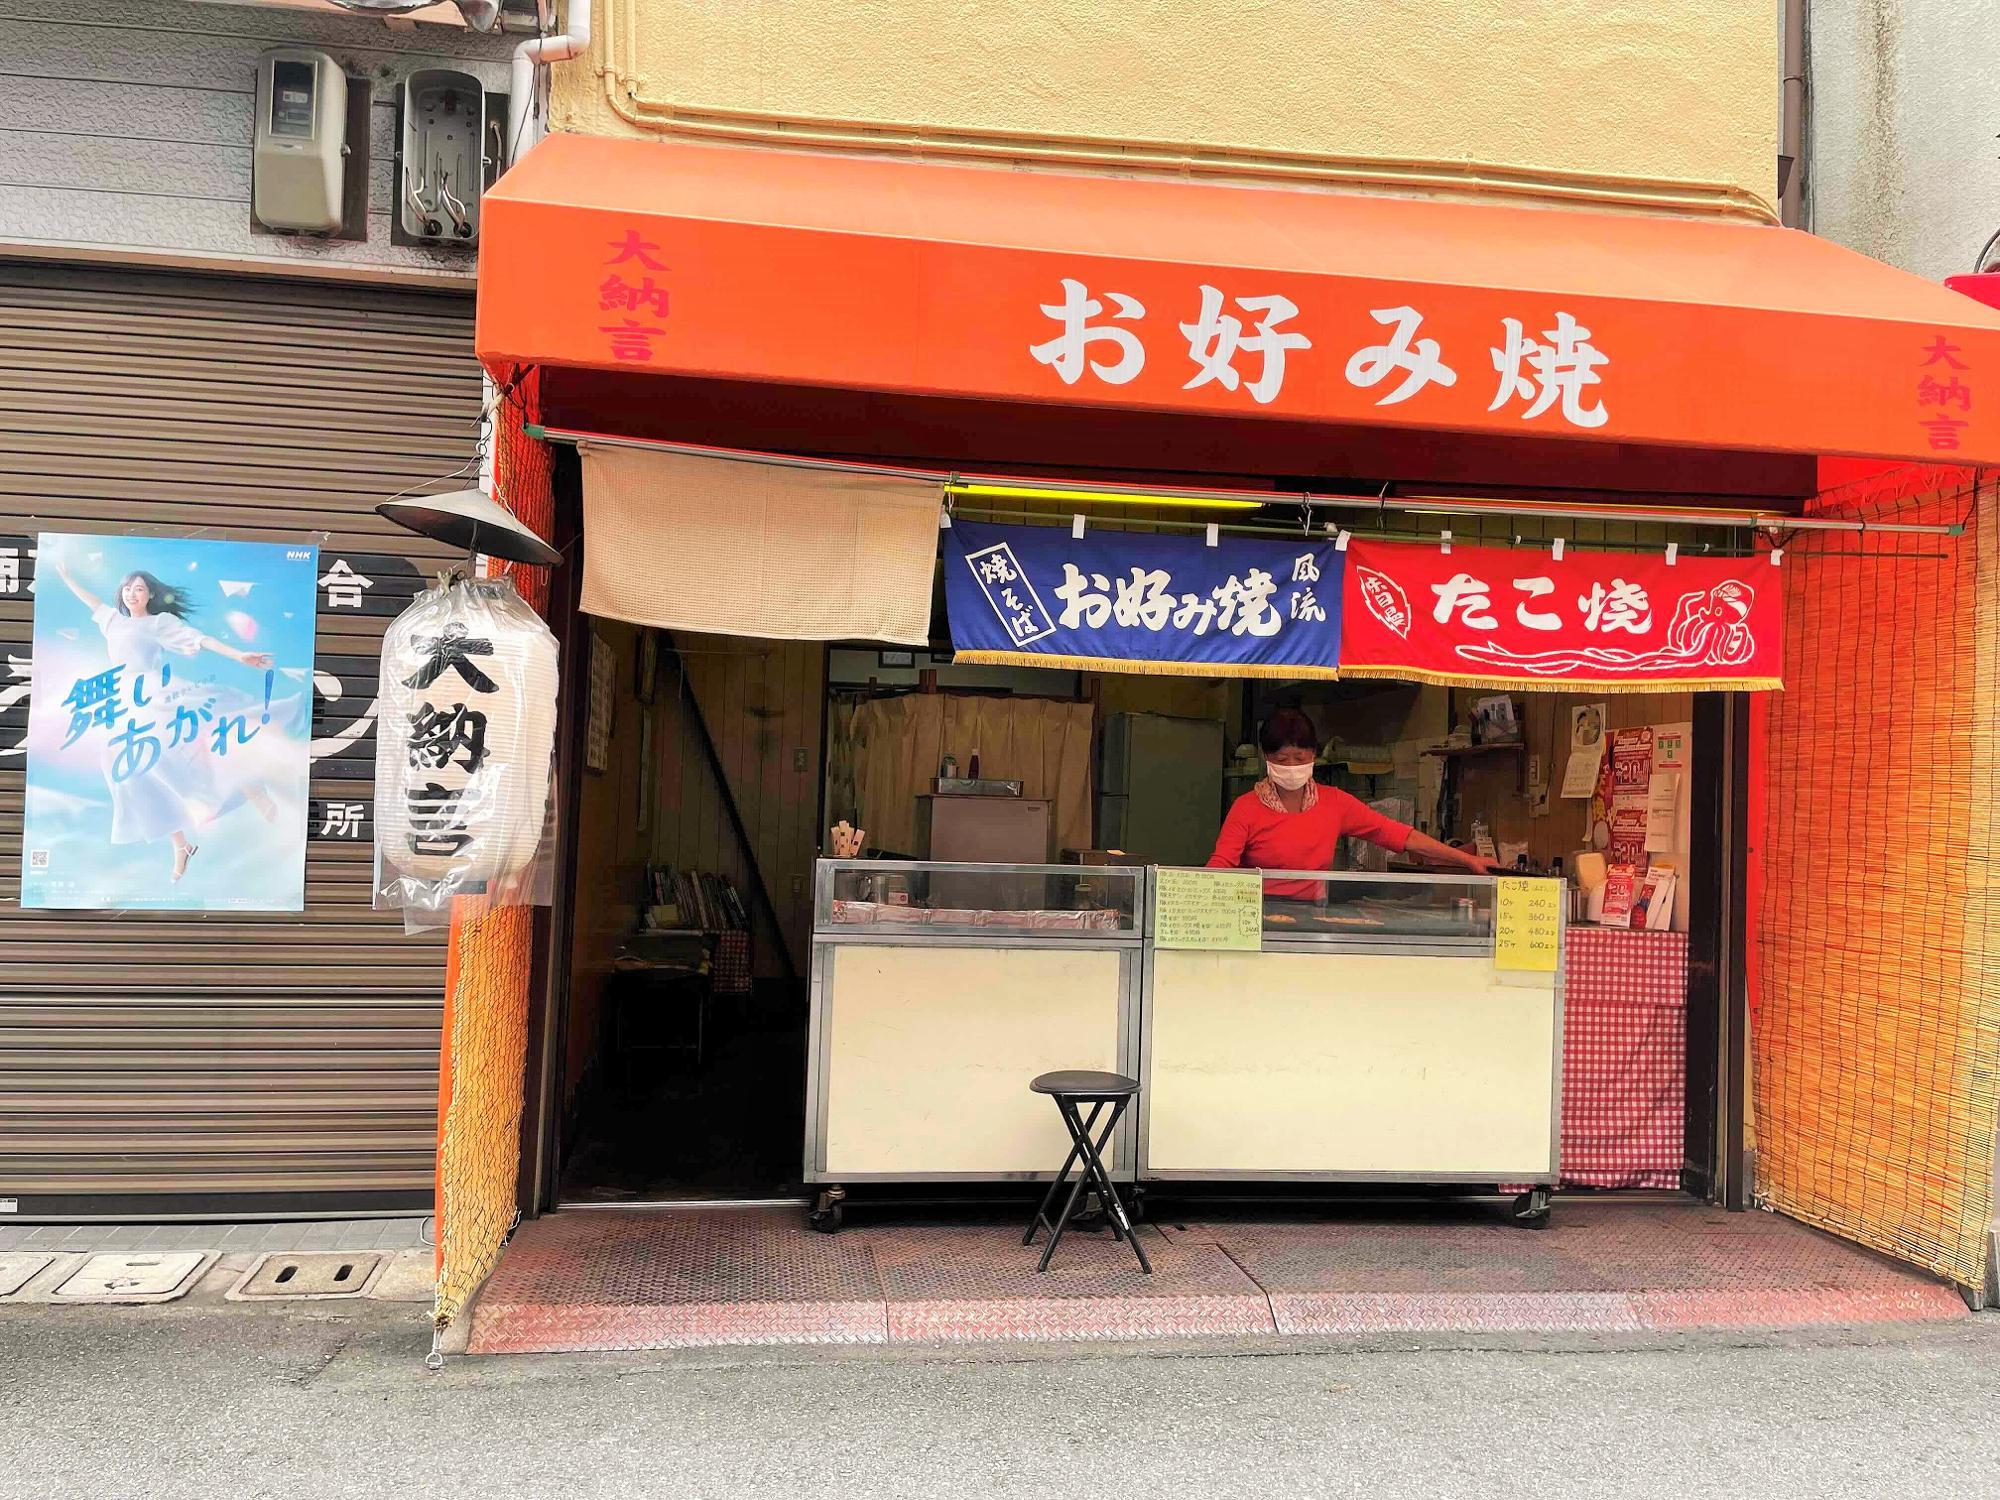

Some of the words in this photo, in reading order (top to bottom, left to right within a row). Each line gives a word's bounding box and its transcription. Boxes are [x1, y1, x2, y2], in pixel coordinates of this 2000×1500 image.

[598, 229, 672, 361] 大納言
[1030, 278, 1609, 428] お好み焼
[1916, 335, 1972, 451] 大納言
[286, 550, 311, 560] NHK
[980, 553, 1040, 639] 焼そば
[1289, 553, 1327, 622] 風流
[1055, 563, 1282, 638] お好み焼
[1430, 572, 1654, 634] たこ焼
[60, 663, 171, 751] 舞い
[401, 622, 500, 857] 大納言
